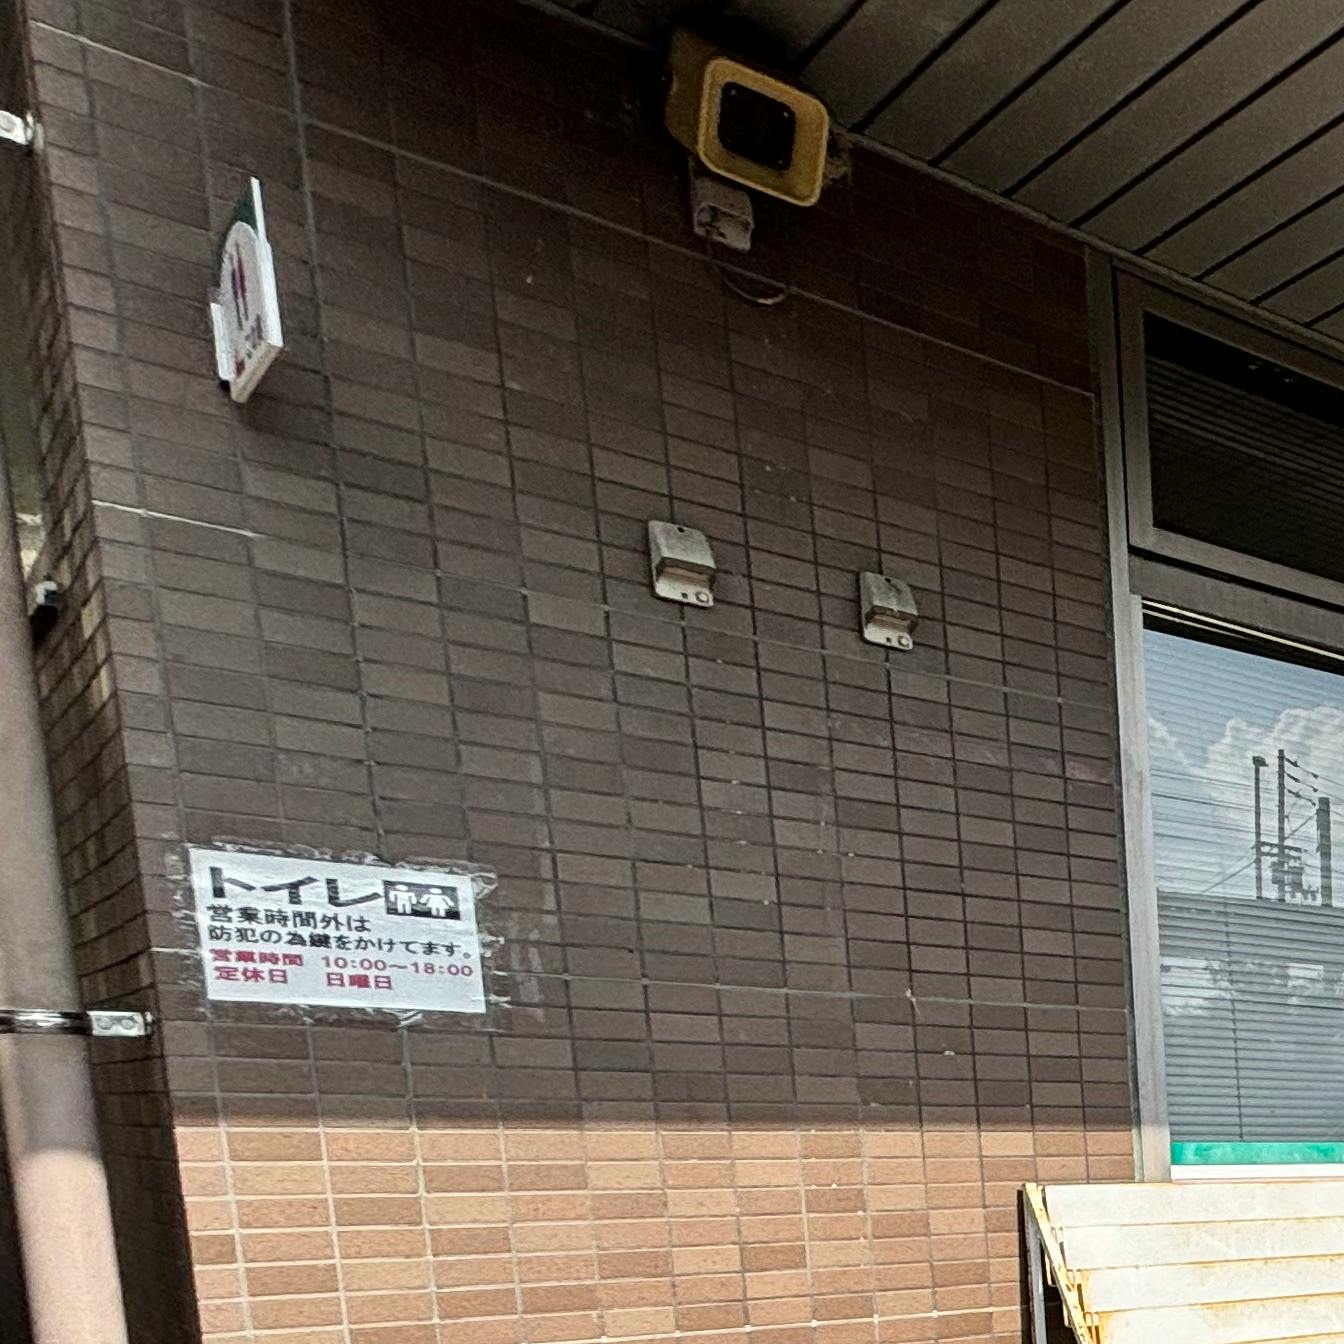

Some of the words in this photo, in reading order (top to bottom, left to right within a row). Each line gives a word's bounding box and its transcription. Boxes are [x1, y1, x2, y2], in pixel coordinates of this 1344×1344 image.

[209, 866, 383, 908] トイレ
[206, 904, 371, 933] 営業時間外は
[208, 925, 472, 960] 防犯の為鍵をかけてます。
[209, 950, 304, 967] 営業時間
[213, 966, 289, 984] 定休日
[326, 973, 393, 990] 日曜日
